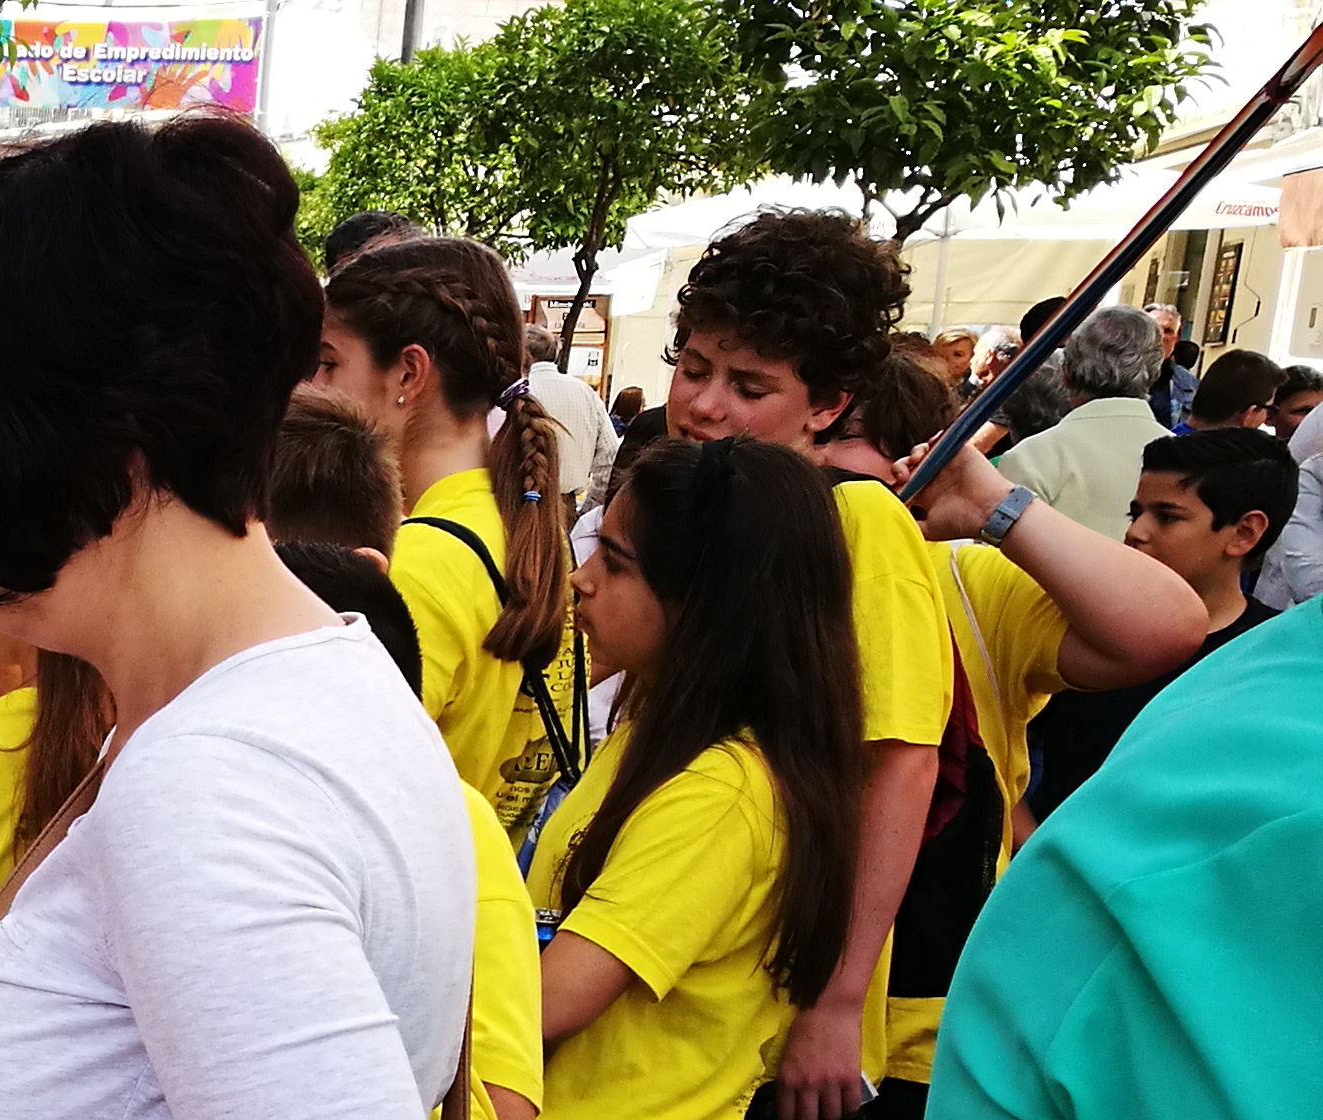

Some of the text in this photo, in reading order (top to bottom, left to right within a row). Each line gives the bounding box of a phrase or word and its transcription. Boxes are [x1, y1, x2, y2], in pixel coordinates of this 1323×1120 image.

[59, 43, 87, 60] de
[92, 43, 254, 63] Empredimiento
[61, 64, 147, 84] Escolar
